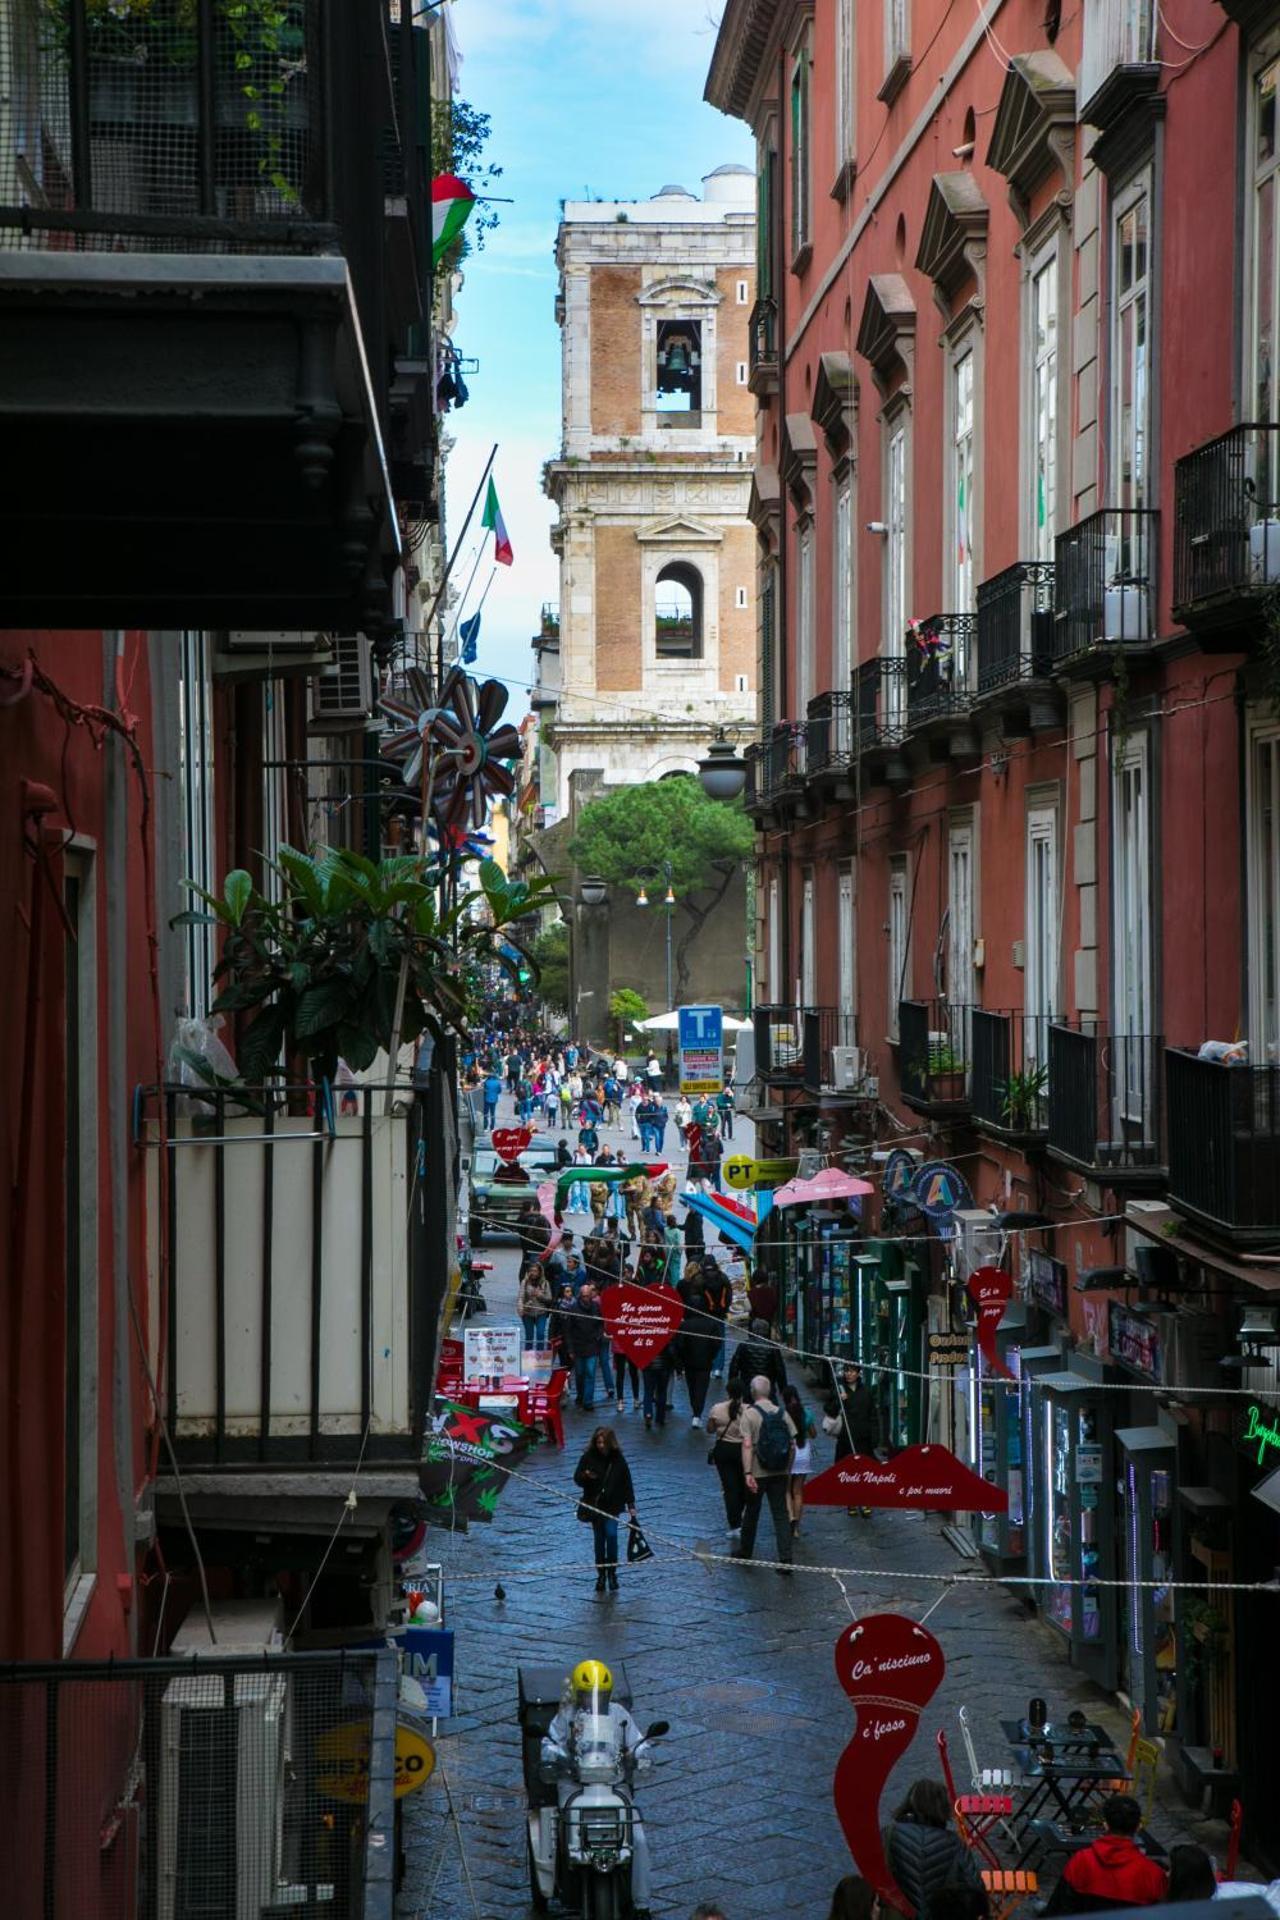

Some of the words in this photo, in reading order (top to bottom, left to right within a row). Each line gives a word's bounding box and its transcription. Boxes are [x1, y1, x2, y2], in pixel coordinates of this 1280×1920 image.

[729, 1164, 752, 1179] PT
[926, 1174, 954, 1207] A
[620, 1302, 636, 1312] Un
[637, 1304, 662, 1315] giorno
[633, 1338, 643, 1347] di
[645, 1338, 654, 1347] te
[837, 1471, 861, 1484] Vedi
[861, 1471, 897, 1486] Napoli
[899, 1487, 905, 1495] e
[905, 1486, 923, 1498] poi
[924, 1486, 953, 1496] muori
[873, 1719, 906, 1741] fesso
